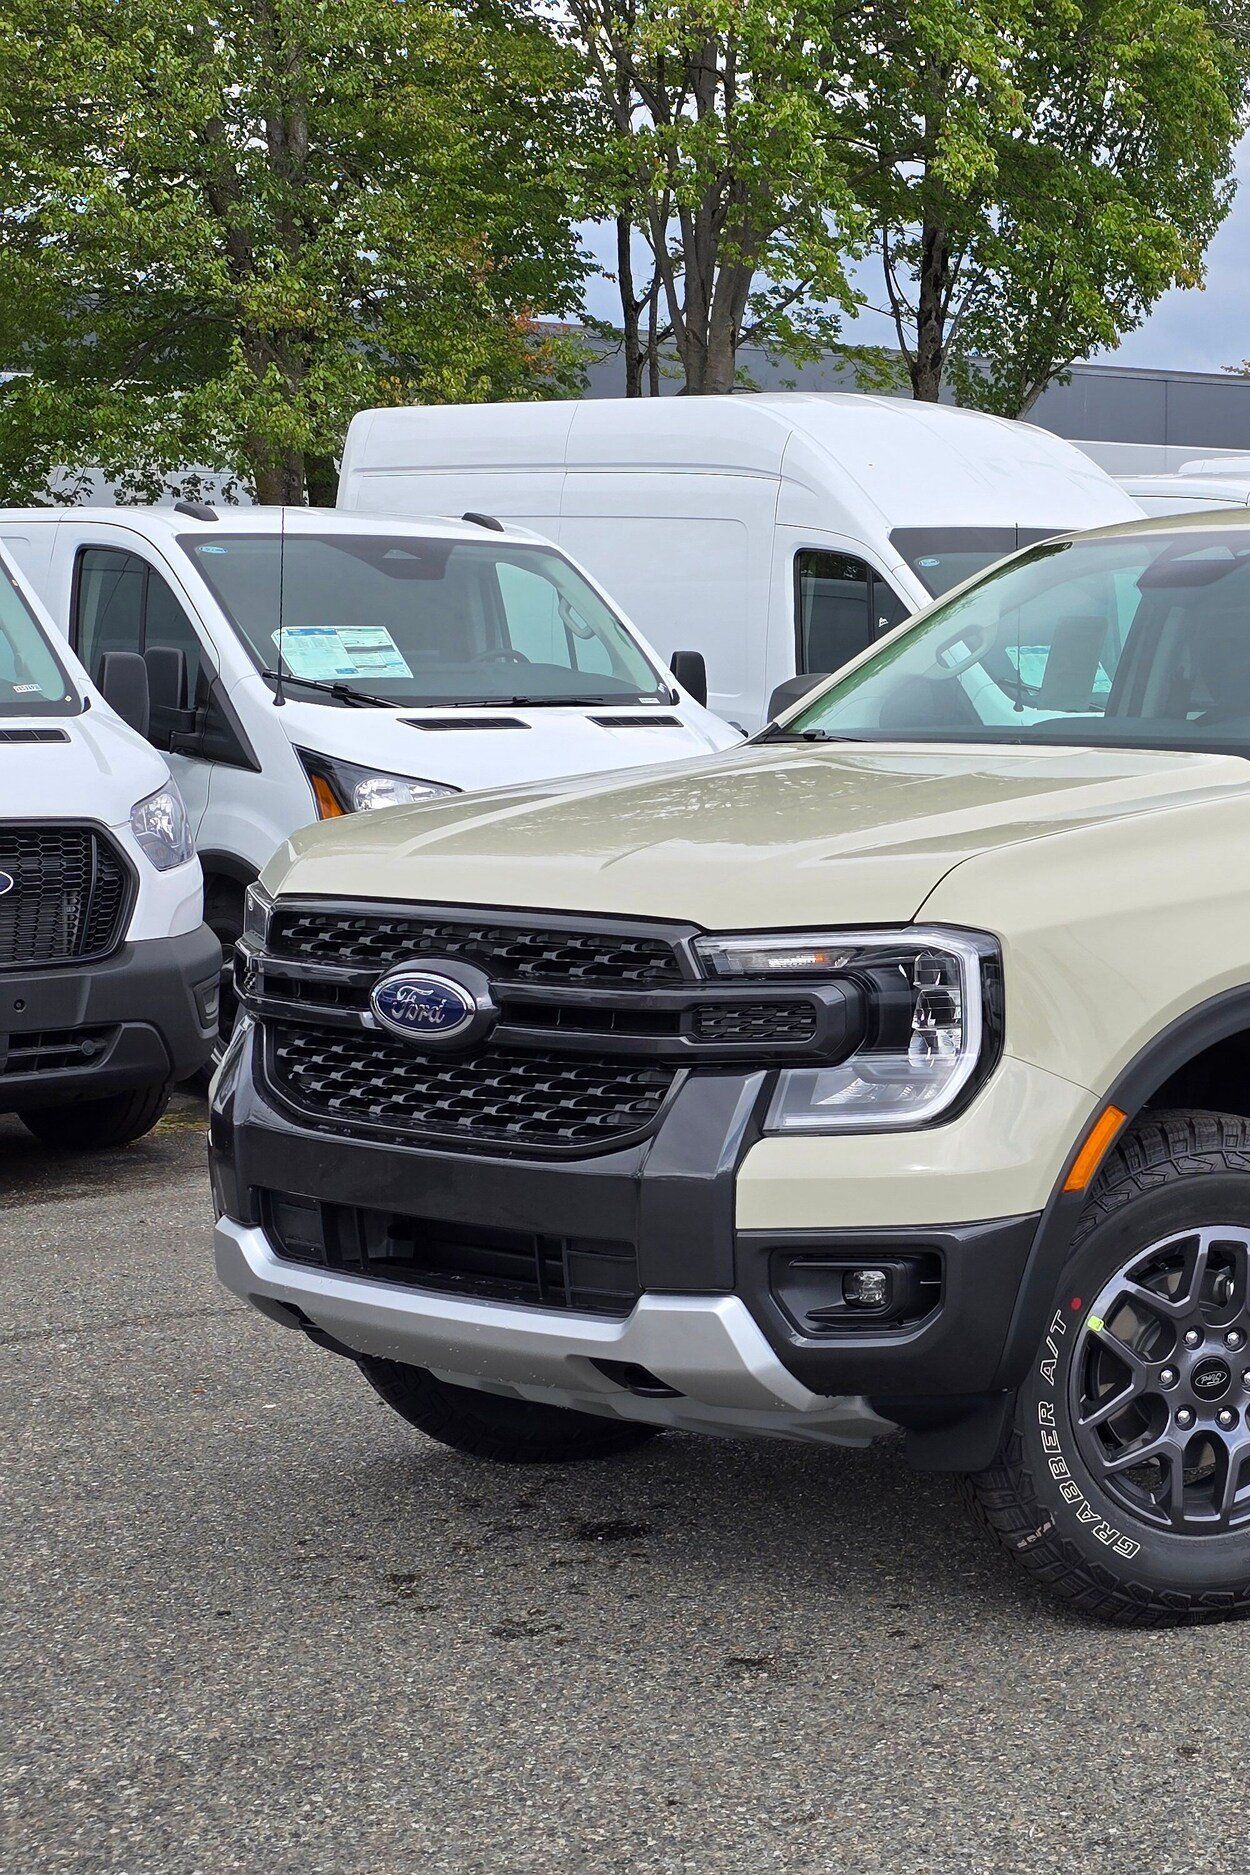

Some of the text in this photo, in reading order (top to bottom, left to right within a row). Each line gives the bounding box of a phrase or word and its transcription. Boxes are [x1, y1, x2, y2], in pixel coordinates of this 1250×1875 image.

[391, 985, 448, 1024] Ford
[1038, 1309, 1141, 1559] GRABBER A/T
